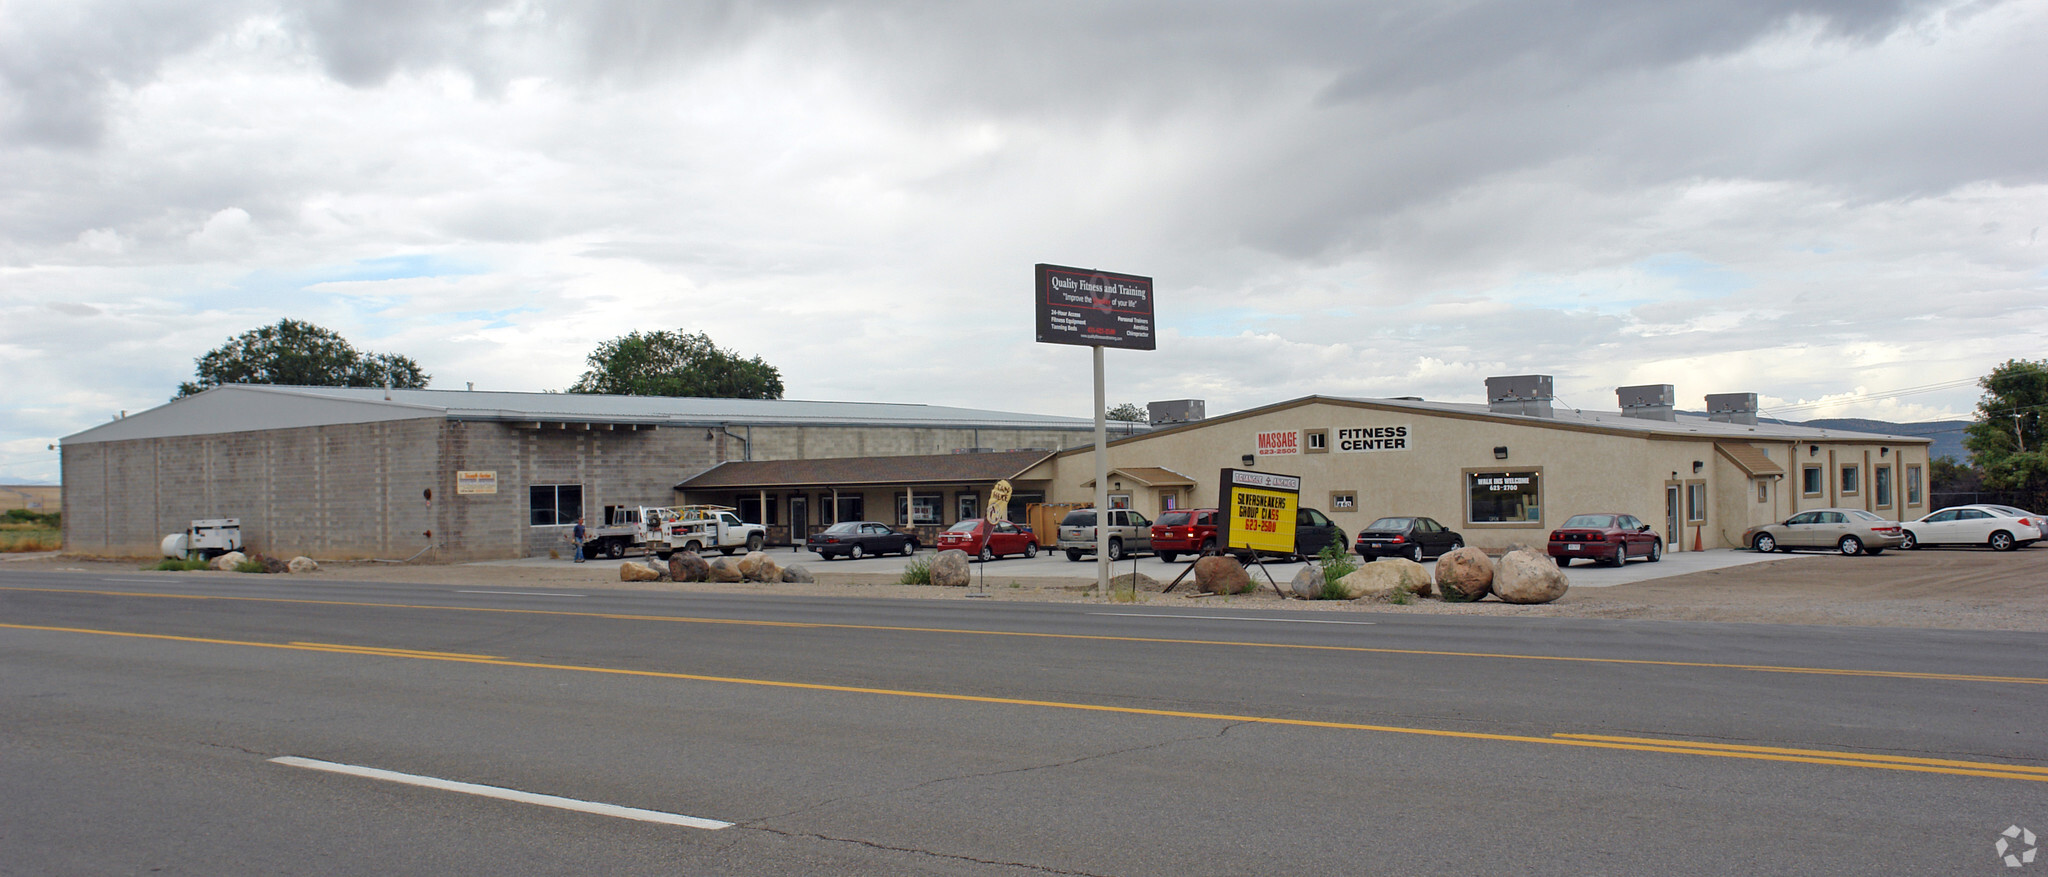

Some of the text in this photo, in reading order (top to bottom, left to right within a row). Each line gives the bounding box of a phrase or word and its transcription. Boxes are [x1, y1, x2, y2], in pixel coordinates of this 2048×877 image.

[1052, 277, 1146, 300] Quality Fitness and Training
[1339, 427, 1407, 439] FITNESS
[1259, 432, 1297, 448] MASSAGE
[1341, 438, 1406, 450] CENTER
[998, 484, 1010, 493] TAN
[993, 491, 1008, 502] HERE
[1238, 493, 1286, 509] SILVERSNEAKERS
[1239, 506, 1279, 520] GROUP CLASS
